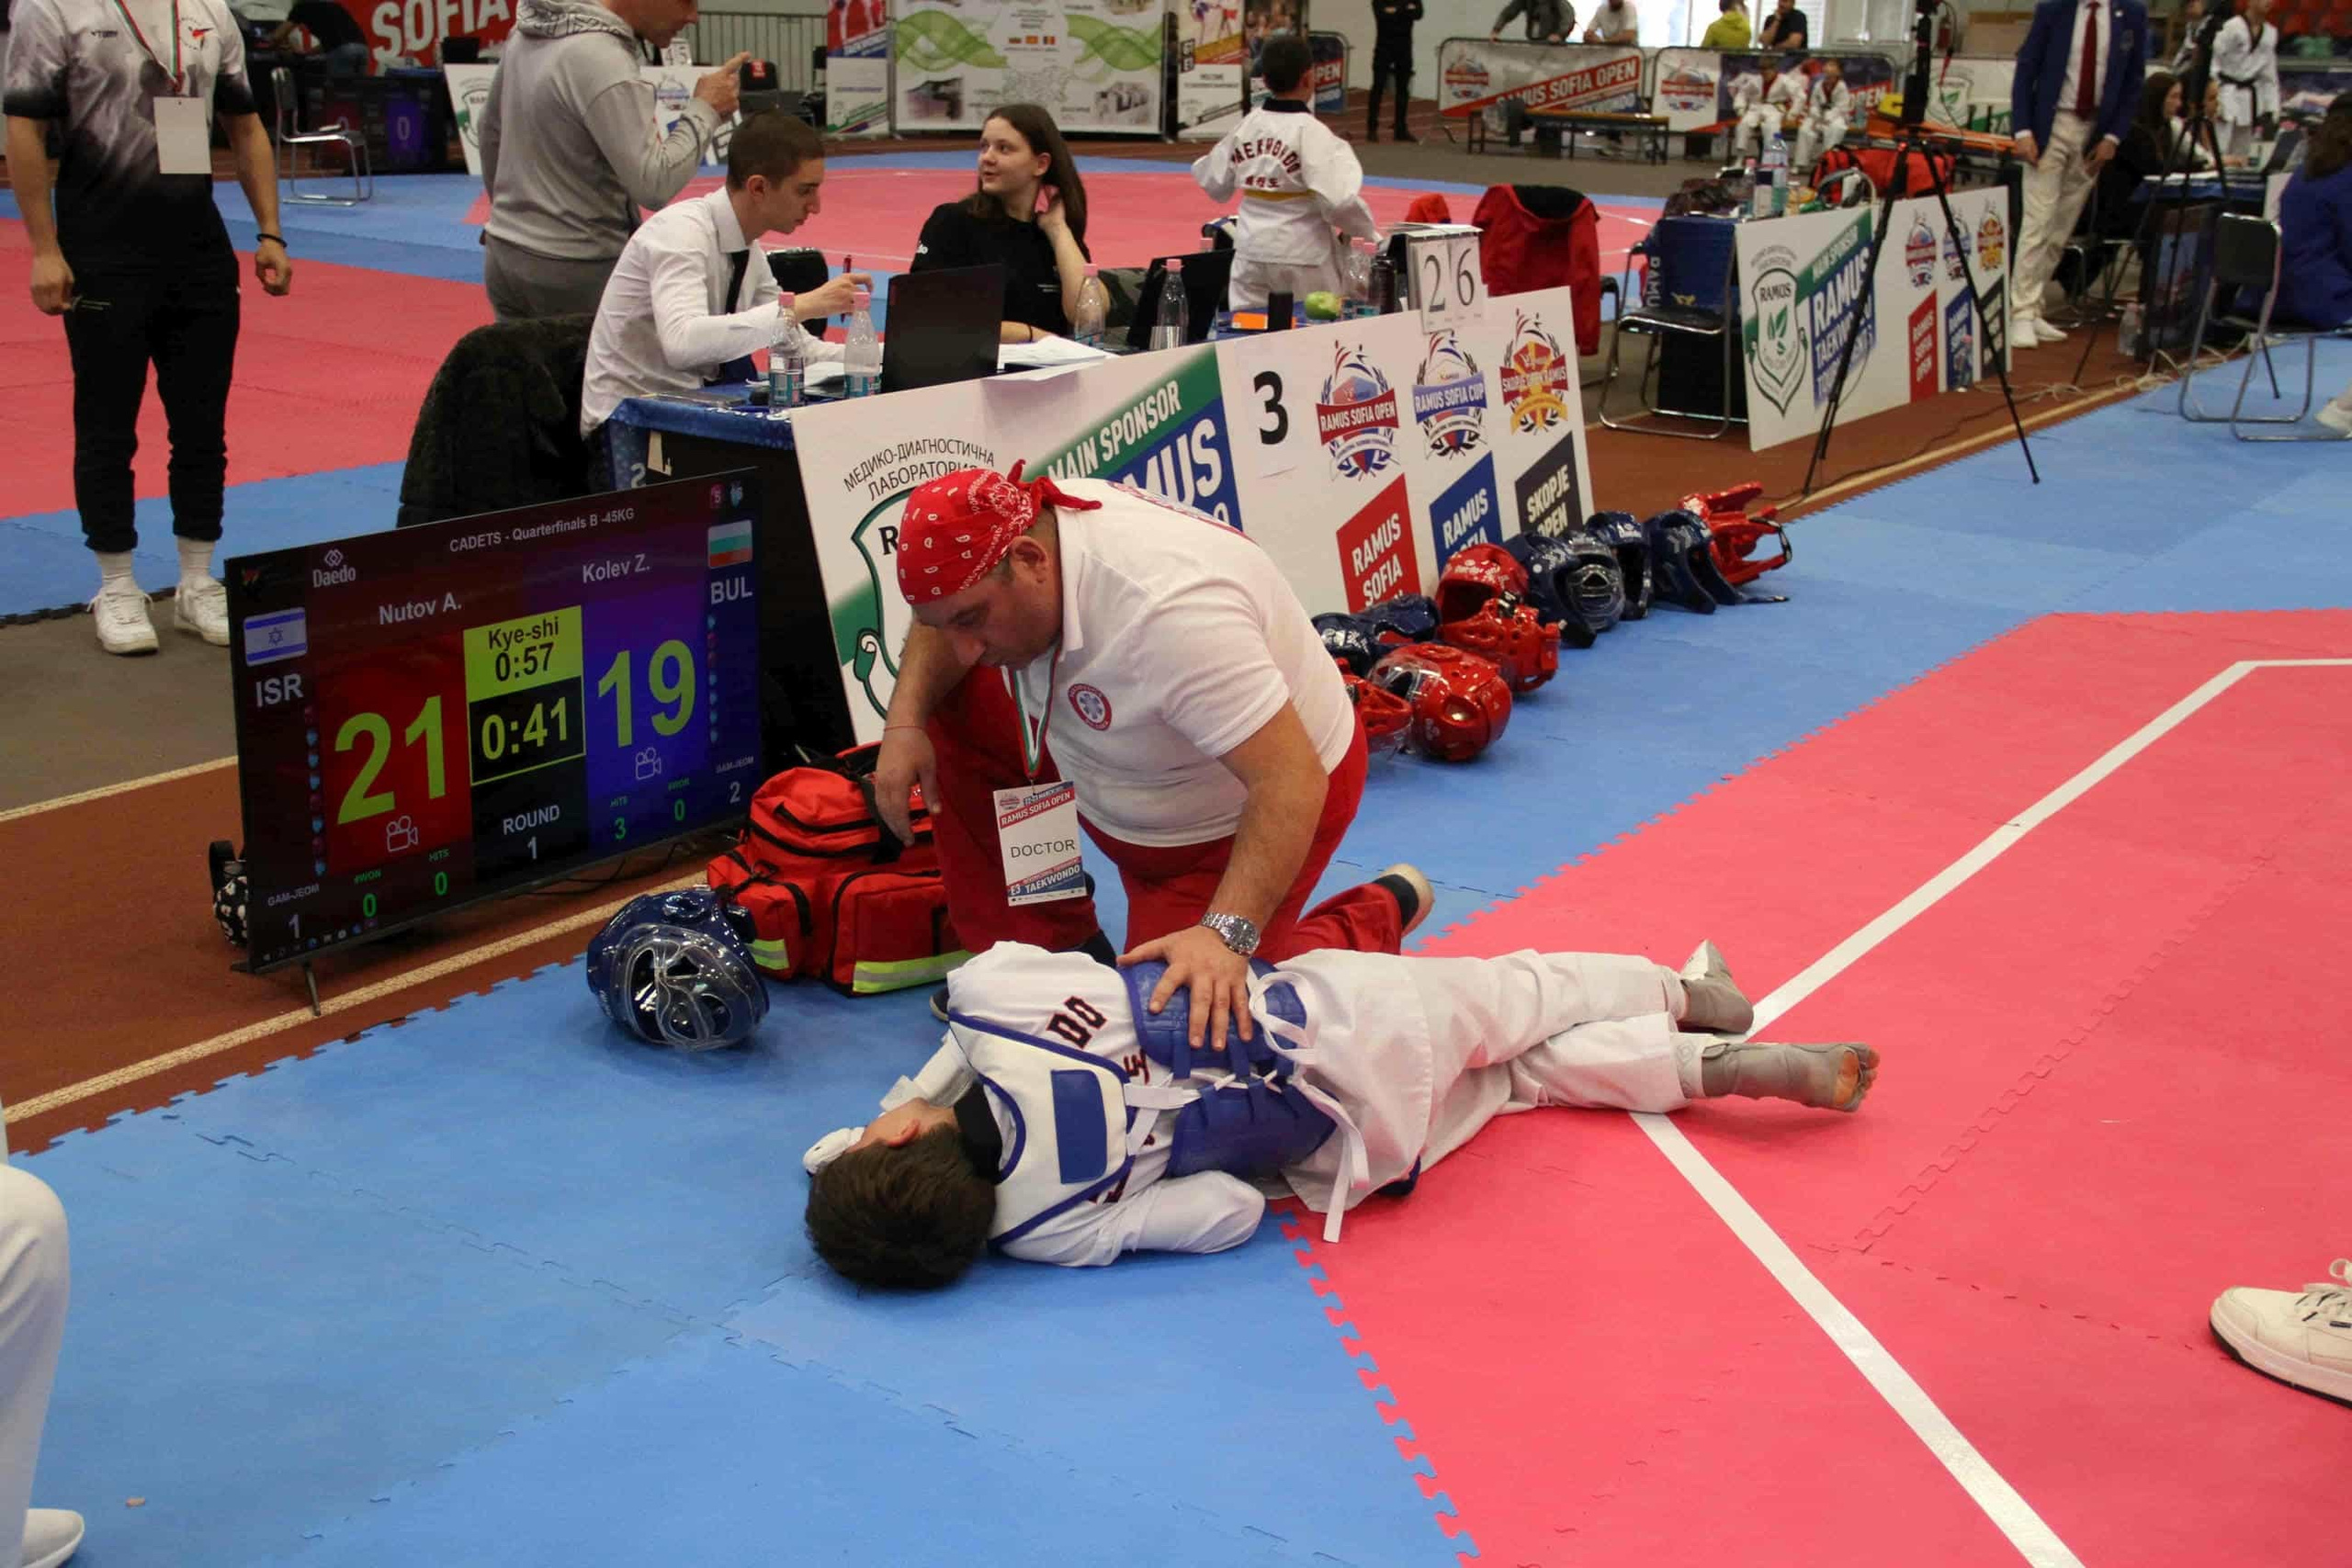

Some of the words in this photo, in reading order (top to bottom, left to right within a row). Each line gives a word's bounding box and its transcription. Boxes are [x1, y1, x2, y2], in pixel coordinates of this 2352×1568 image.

[372, 0, 511, 62] SOFIA
[1549, 73, 1592, 99] SOFIA
[1596, 60, 1636, 86] OPEN
[1424, 248, 1476, 313] 26
[1253, 370, 1289, 446] 3
[1415, 391, 1445, 412] RAMUS
[1445, 387, 1468, 407] SOFIA
[1468, 382, 1485, 402] CUP
[1047, 435, 1100, 479] MAIN
[1100, 379, 1182, 462] SPONSOR
[1320, 411, 1351, 433] RAMUS
[1351, 406, 1374, 424] SOFIA
[1374, 400, 1396, 420] OPEN
[843, 438, 995, 492] МЕДИКО-ДИАГНОСТИЧНА
[868, 460, 978, 502] ЛАБОРАТОР
[1526, 464, 1570, 524] SKOPJE
[449, 531, 502, 553] CADETS
[513, 516, 587, 542] Quarterfinals
[590, 513, 598, 527] B
[602, 507, 636, 525] -45KG
[1442, 488, 1489, 549] RAMUS
[1351, 513, 1402, 578] RAMUS
[312, 564, 356, 589] Daedo
[582, 558, 630, 584] Kolev
[635, 554, 650, 573] Z.
[1362, 554, 1403, 607] SOFIA
[710, 576, 753, 605] BUL
[379, 600, 436, 626] Nutov
[442, 592, 462, 613] A.
[488, 616, 560, 650] Kye-shi
[494, 643, 556, 683] 0:57
[255, 672, 304, 708] ISR
[597, 639, 697, 750] 19
[481, 695, 569, 761] 0:41
[334, 694, 447, 826] 21
[673, 798, 686, 821] 0
[729, 781, 741, 804] 2
[1001, 809, 1029, 827] RAMUS
[1029, 799, 1051, 816] SOFIA
[1051, 791, 1071, 806] OPEN
[503, 805, 561, 836] ROUND
[614, 817, 627, 840] 3
[428, 849, 450, 863] HITS
[526, 837, 539, 861] 1
[1010, 839, 1076, 859] DOCTOR
[267, 883, 320, 907] GAM-JEOM
[435, 871, 449, 896] 0
[1024, 864, 1081, 894] TAEKWONDO
[362, 893, 378, 918] 0
[288, 913, 300, 939] 1
